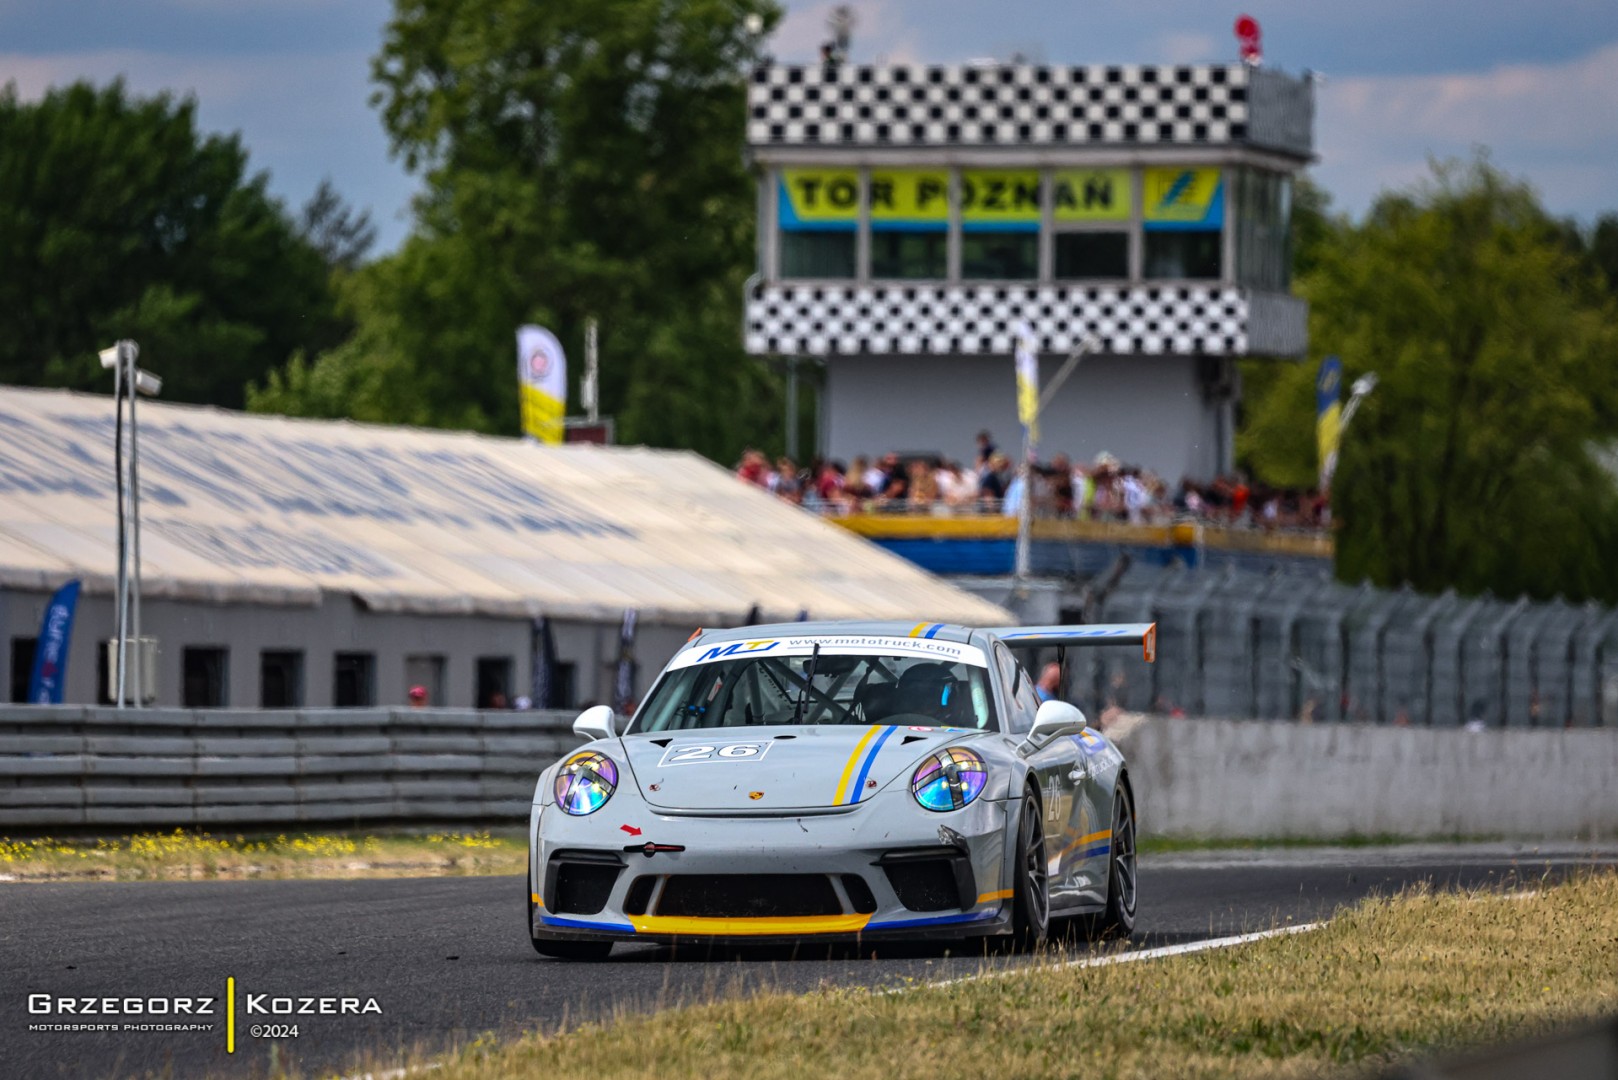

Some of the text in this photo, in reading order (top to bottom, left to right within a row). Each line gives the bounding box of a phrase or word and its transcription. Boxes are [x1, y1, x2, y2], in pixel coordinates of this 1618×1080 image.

[797, 178, 894, 210] TOR
[789, 637, 962, 655] www.mototruck.com
[668, 745, 762, 761] 26
[1047, 774, 1061, 822] 26
